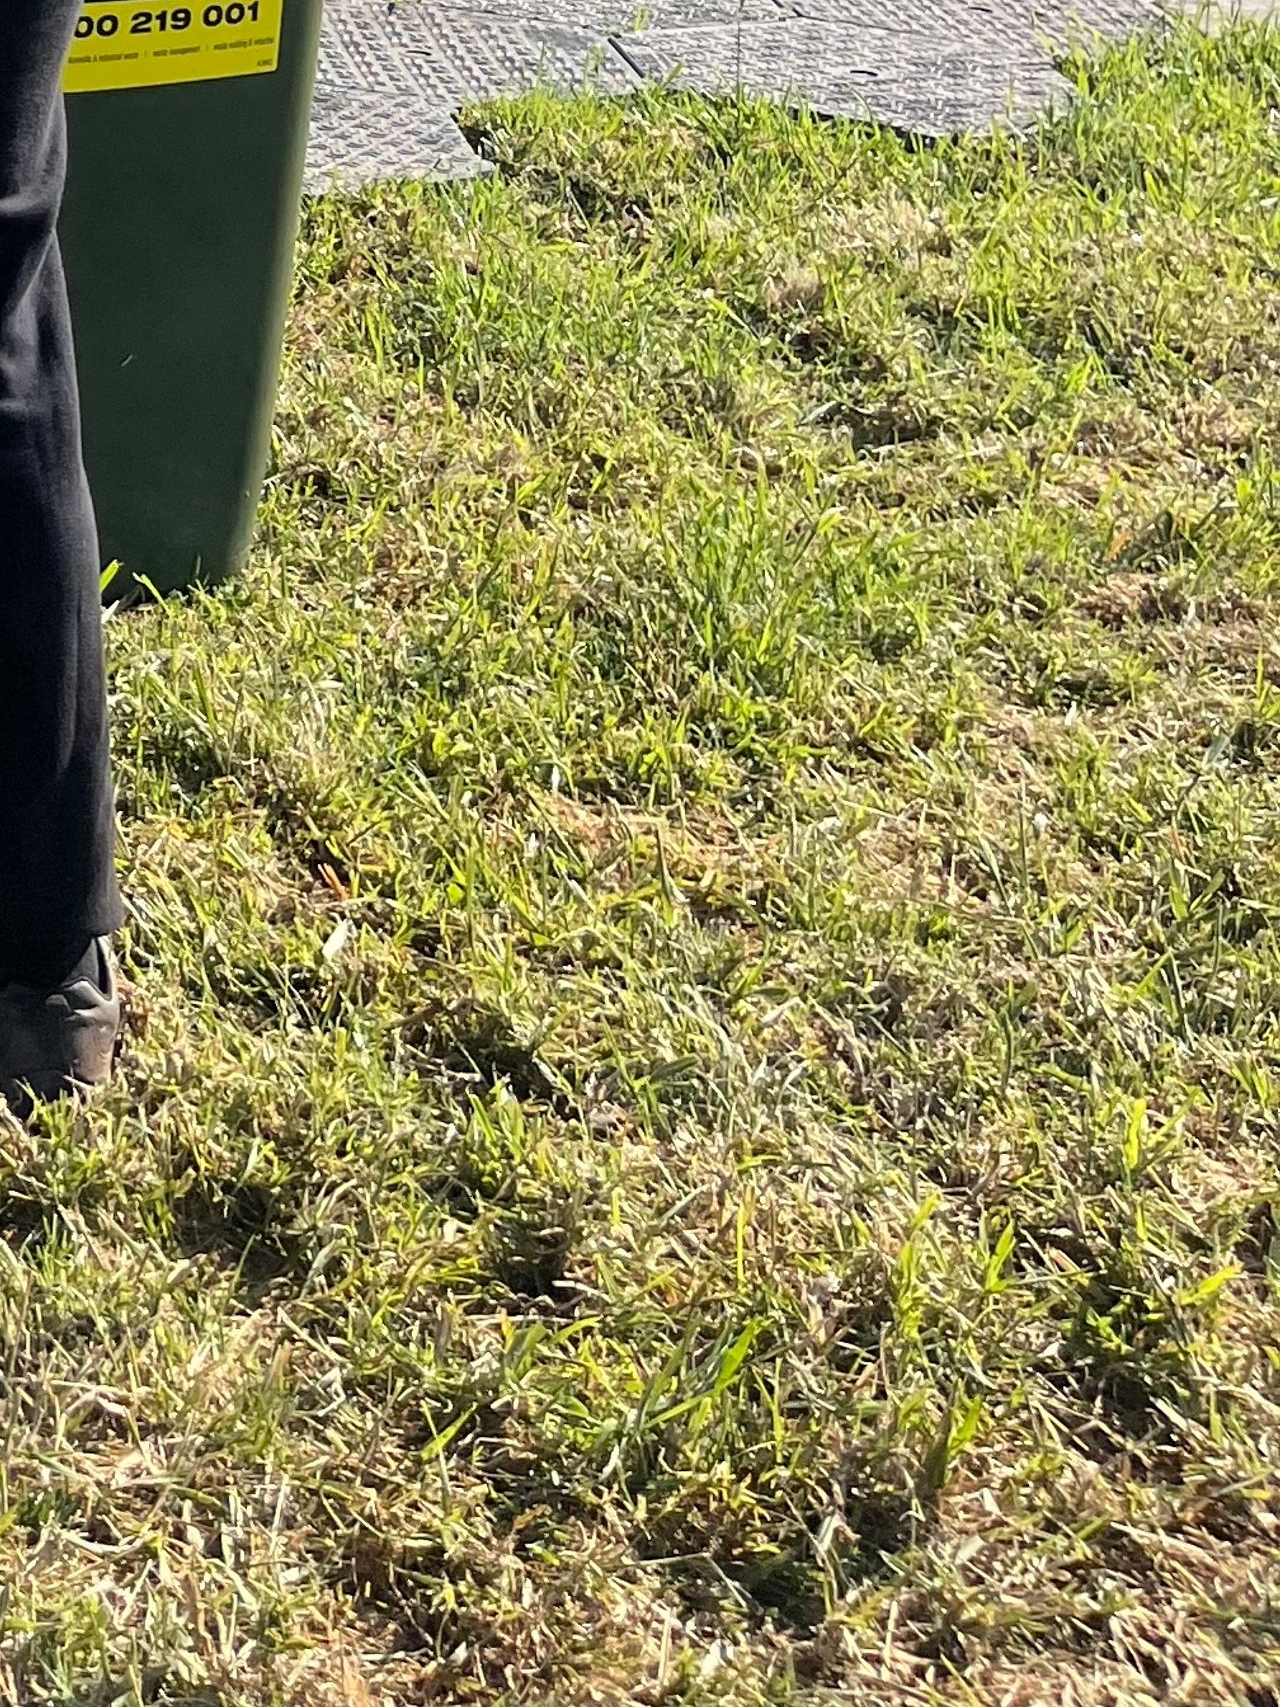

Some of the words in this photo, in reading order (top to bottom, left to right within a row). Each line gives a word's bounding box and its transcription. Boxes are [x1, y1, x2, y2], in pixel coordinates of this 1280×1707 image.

[73, 14, 119, 38] 00
[129, 7, 192, 34] 219
[203, 0, 259, 27] 001
